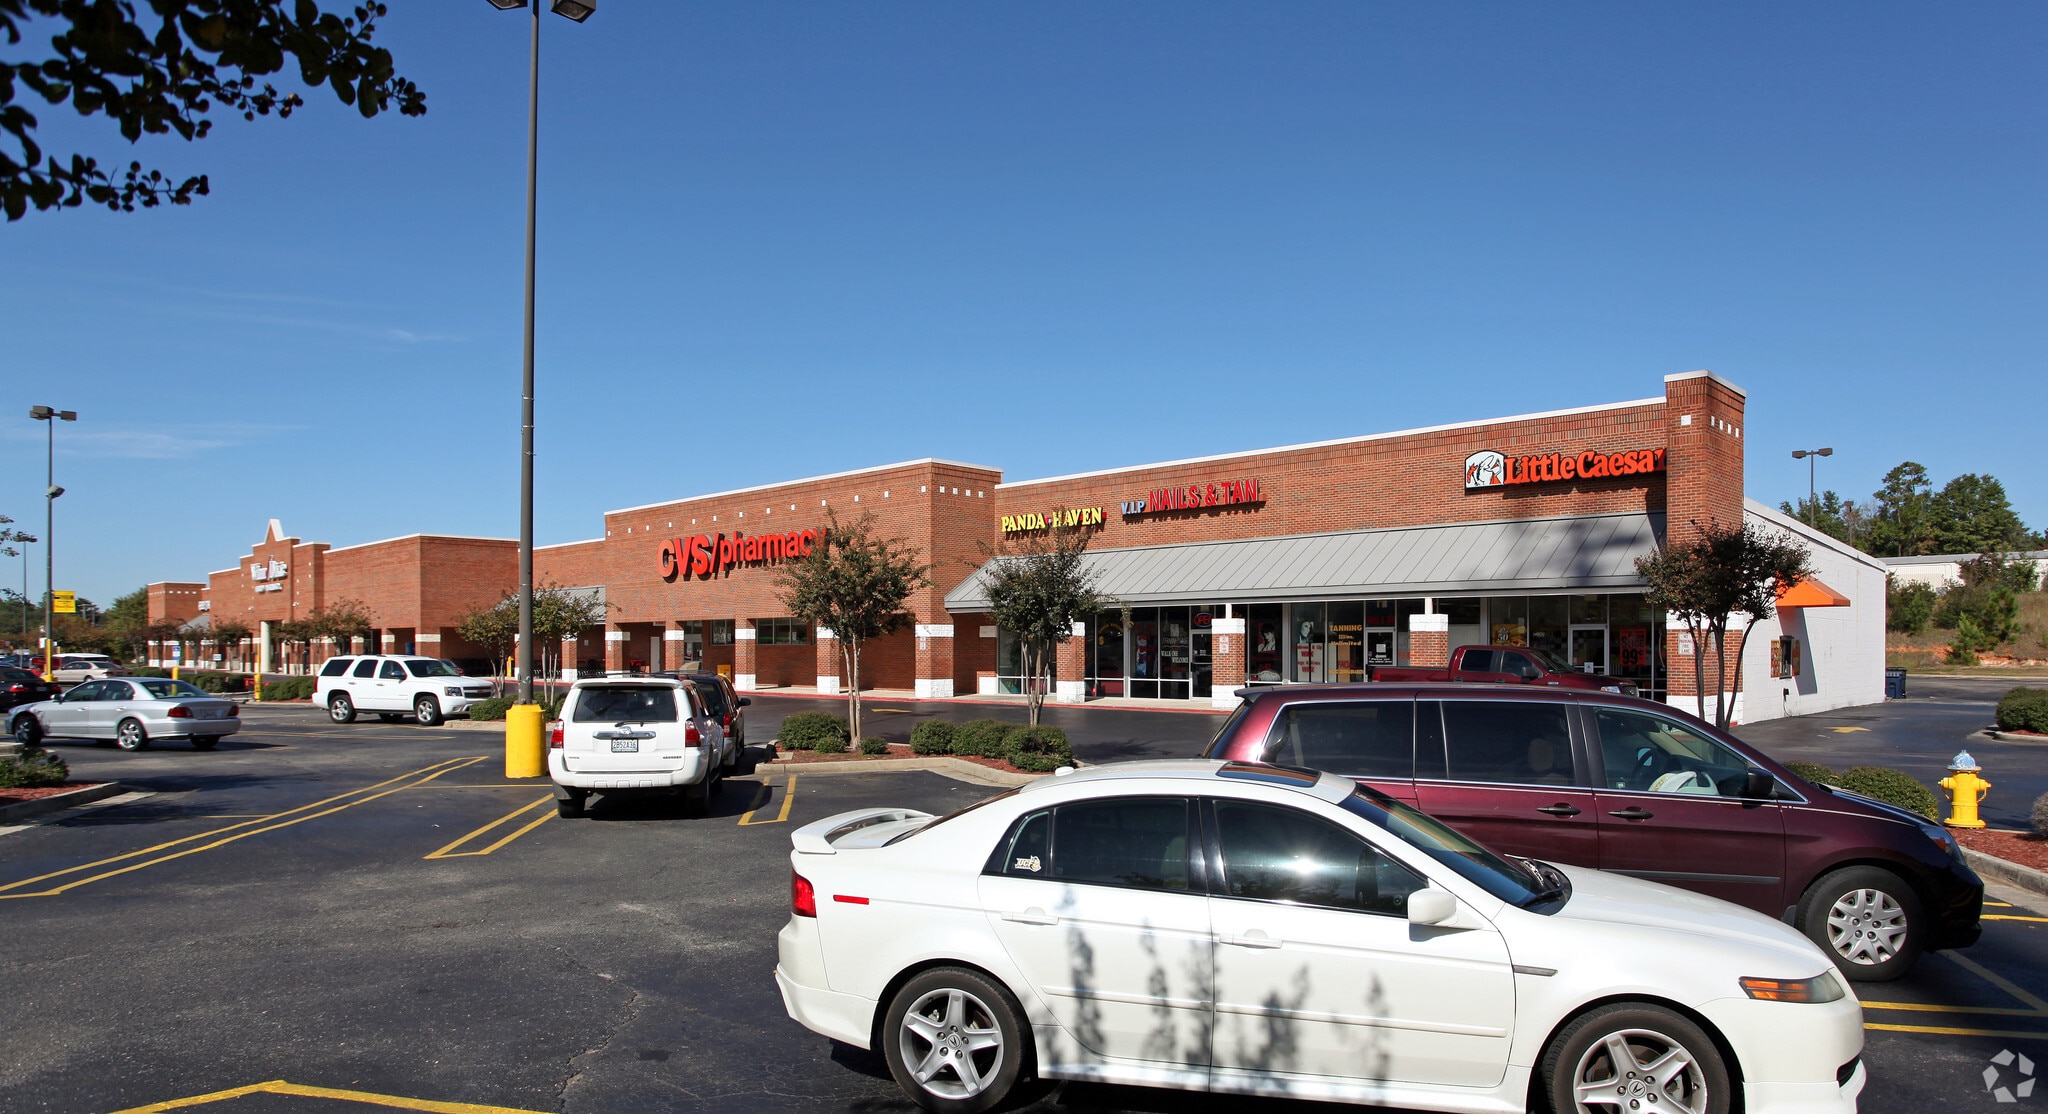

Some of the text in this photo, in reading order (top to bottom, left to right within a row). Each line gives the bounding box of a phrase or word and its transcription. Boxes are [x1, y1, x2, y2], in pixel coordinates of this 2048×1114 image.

[1503, 453, 1575, 485] Little
[1149, 485, 1199, 512] NAILS
[1204, 484, 1218, 506] &
[1221, 479, 1258, 504] TAN
[1001, 507, 1103, 532] PANDA HAVEN
[1329, 624, 1363, 632] TANNING
